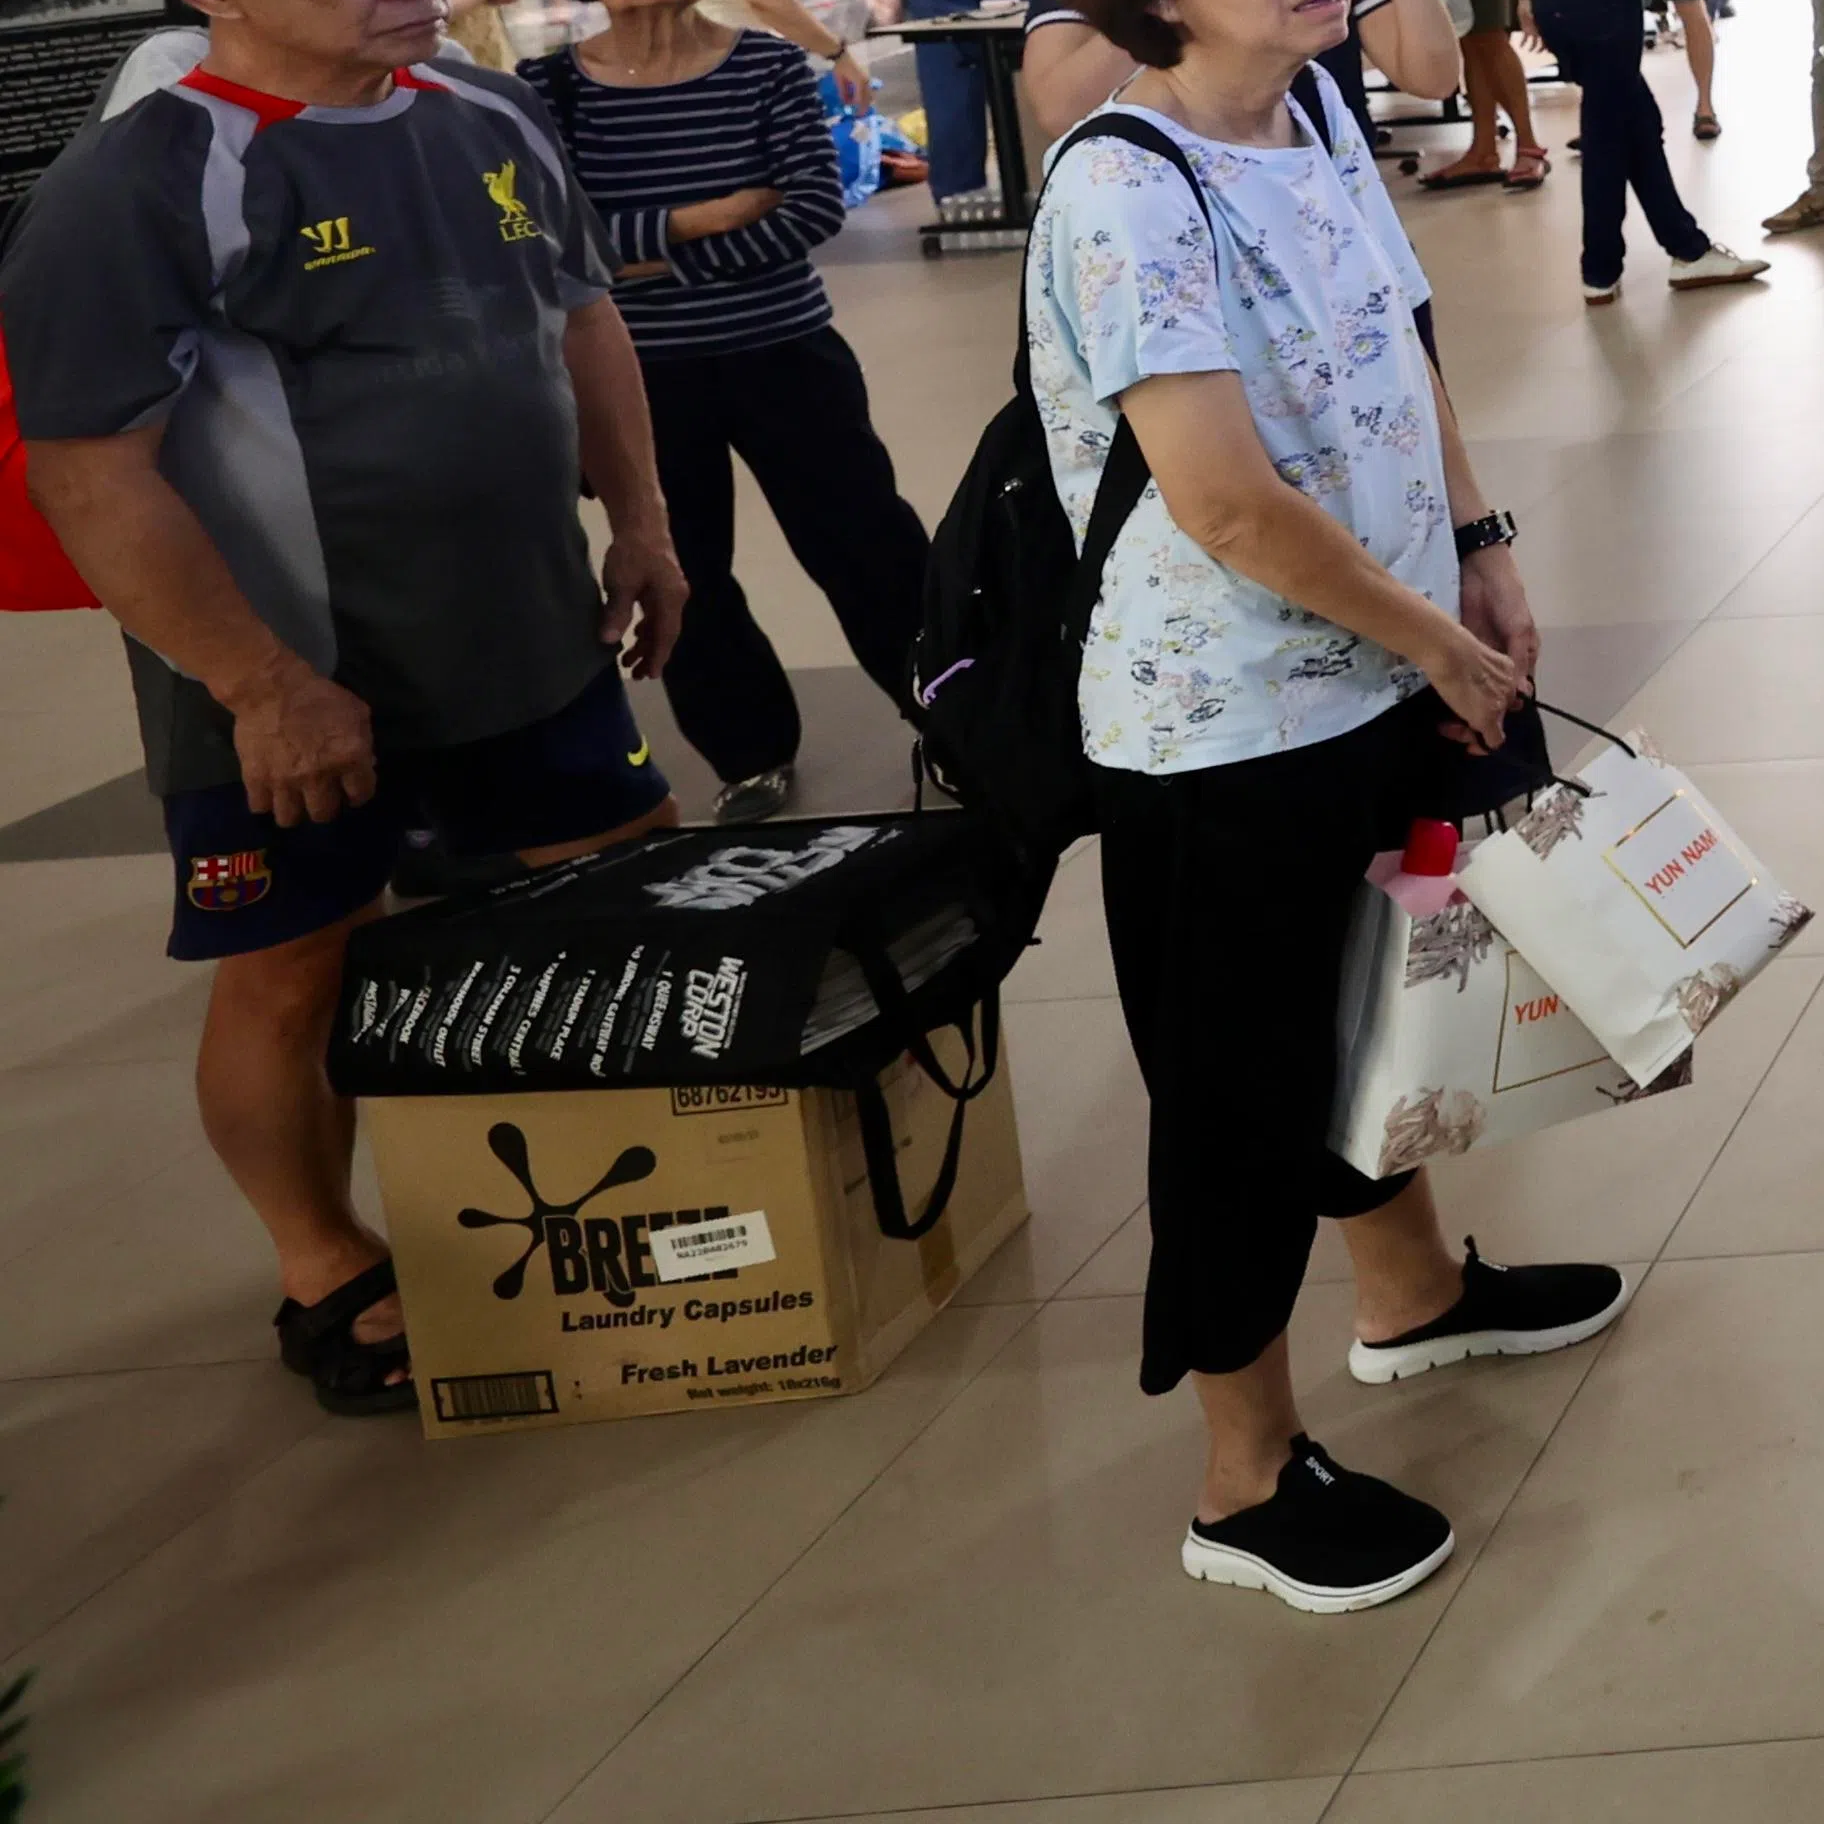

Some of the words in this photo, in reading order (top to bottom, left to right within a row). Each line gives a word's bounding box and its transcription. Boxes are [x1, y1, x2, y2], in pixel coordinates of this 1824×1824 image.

[1645, 863, 1685, 896] YUN
[1681, 828, 1720, 867] NAM
[483, 975, 517, 1025] COLEMAN
[527, 962, 560, 1018] TAMPINES
[564, 977, 592, 1025] STADIUM
[613, 959, 638, 1001] JURONG
[641, 980, 672, 1051] QUEENSWAY
[680, 969, 714, 1038] CORP
[691, 956, 744, 1060] WESTON
[1514, 994, 1560, 1025] YUN
[433, 1026, 448, 1067] OUTLET
[471, 1025, 488, 1066] STREET
[550, 1025, 571, 1061] PLACE
[596, 1002, 619, 1053] GATEWAY
[561, 1305, 676, 1333] Laundry
[684, 1290, 815, 1323] Capsules
[620, 1359, 699, 1384] Fresh
[707, 1344, 839, 1376] Lavender
[686, 1386, 715, 1401] Net
[717, 1381, 773, 1399] weight:
